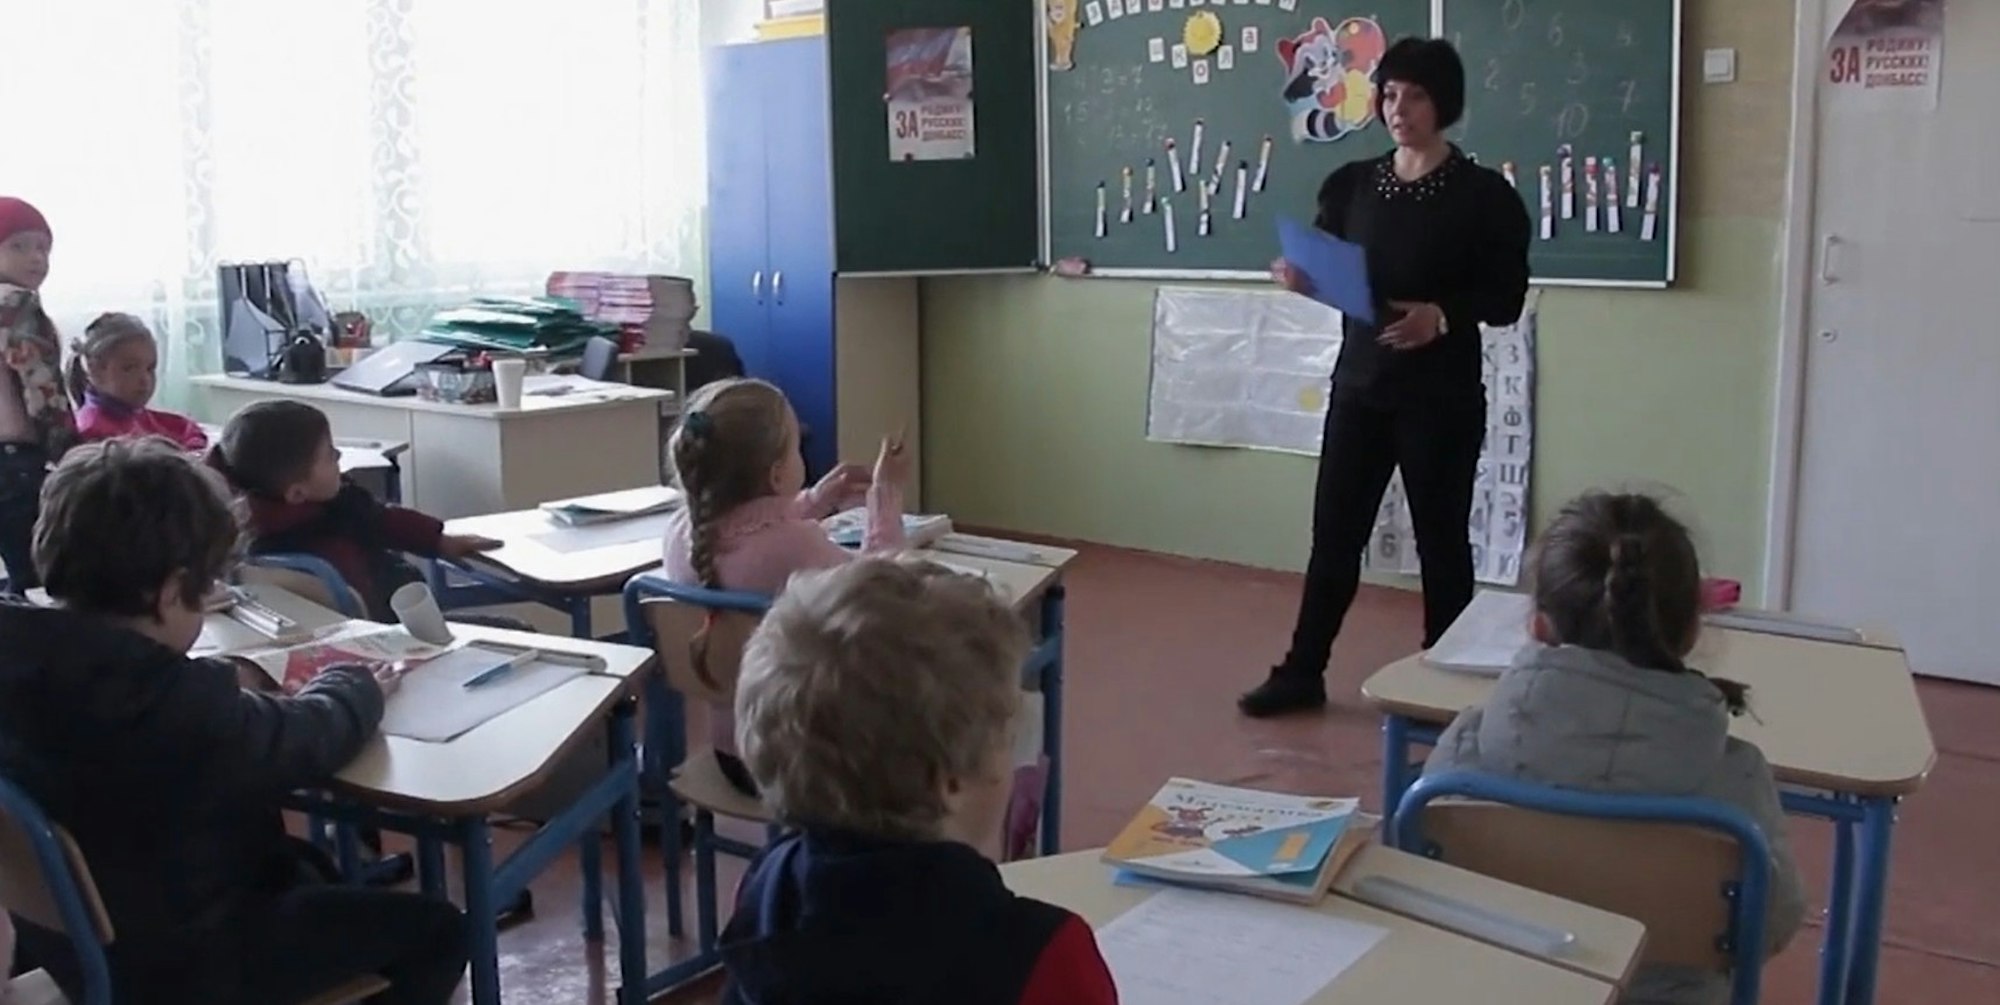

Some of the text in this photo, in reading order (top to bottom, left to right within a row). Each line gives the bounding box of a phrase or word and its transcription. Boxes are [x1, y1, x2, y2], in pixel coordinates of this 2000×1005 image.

[1829, 46, 1860, 84] ЗА
[896, 110, 919, 139] ЗА
[1505, 375, 1522, 395] К
[1503, 405, 1522, 427] Ф
[1504, 434, 1522, 454] Т
[1379, 532, 1396, 559] 6
